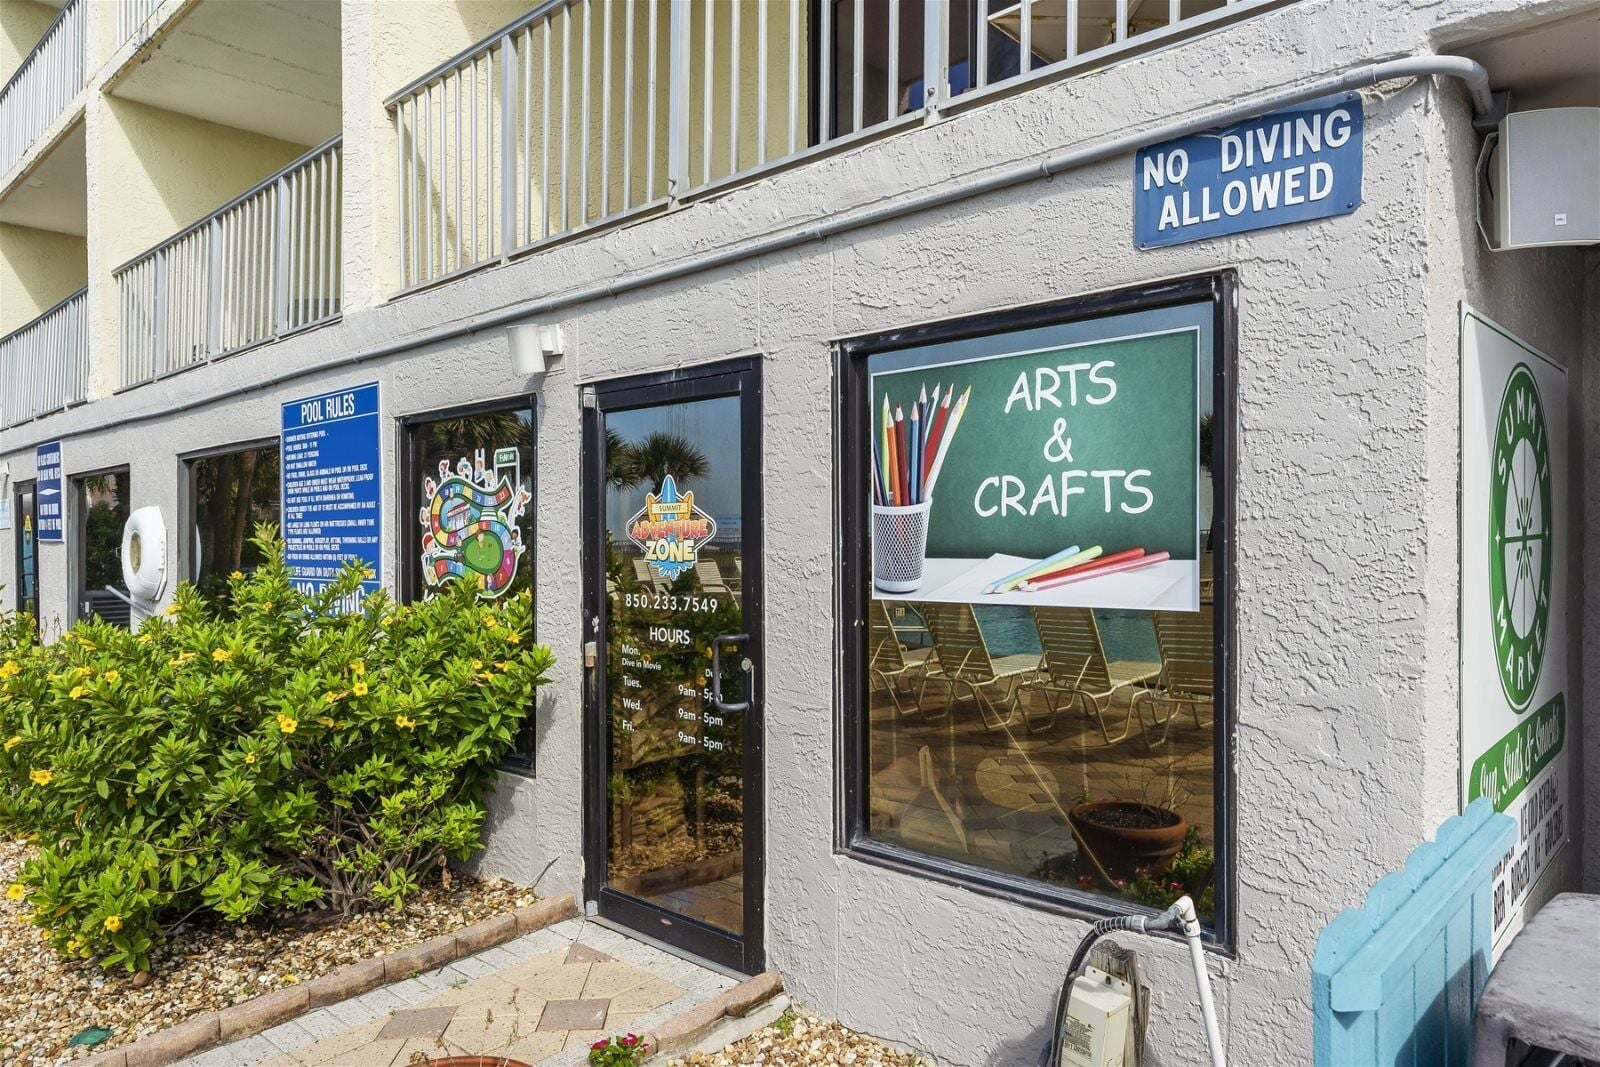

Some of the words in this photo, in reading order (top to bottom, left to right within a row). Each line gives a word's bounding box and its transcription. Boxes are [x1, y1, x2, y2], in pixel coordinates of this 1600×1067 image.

[1143, 148, 1189, 191] NO
[1221, 109, 1351, 173] DIVING
[1158, 161, 1334, 231] ALLOWED
[1004, 360, 1118, 414] ARTS
[301, 401, 324, 424] POOL
[326, 393, 355, 420] RULES
[1043, 417, 1073, 463] &
[1497, 386, 1548, 486] SUMMIT
[974, 469, 1154, 518] CRAFTS
[631, 518, 709, 541] ADVENTURE
[645, 539, 695, 562] ZONE
[625, 593, 718, 613] 850.233.7549
[621, 644, 640, 656] Mon.
[649, 626, 690, 645] HOURS
[1497, 580, 1547, 691] MARKET
[622, 658, 635, 667] Dive
[636, 660, 642, 668] in
[643, 660, 662, 671] Movie
[623, 675, 642, 689] Tues.
[678, 684, 696, 697] 9am
[623, 697, 643, 711] Wed.
[678, 708, 696, 721] 9am
[703, 712, 723, 727] 5pm
[622, 720, 635, 732] Fri.
[678, 731, 696, 745] 9am
[703, 736, 723, 752] 5pm
[1502, 732, 1523, 795] Suds
[1494, 880, 1505, 932] BEER
